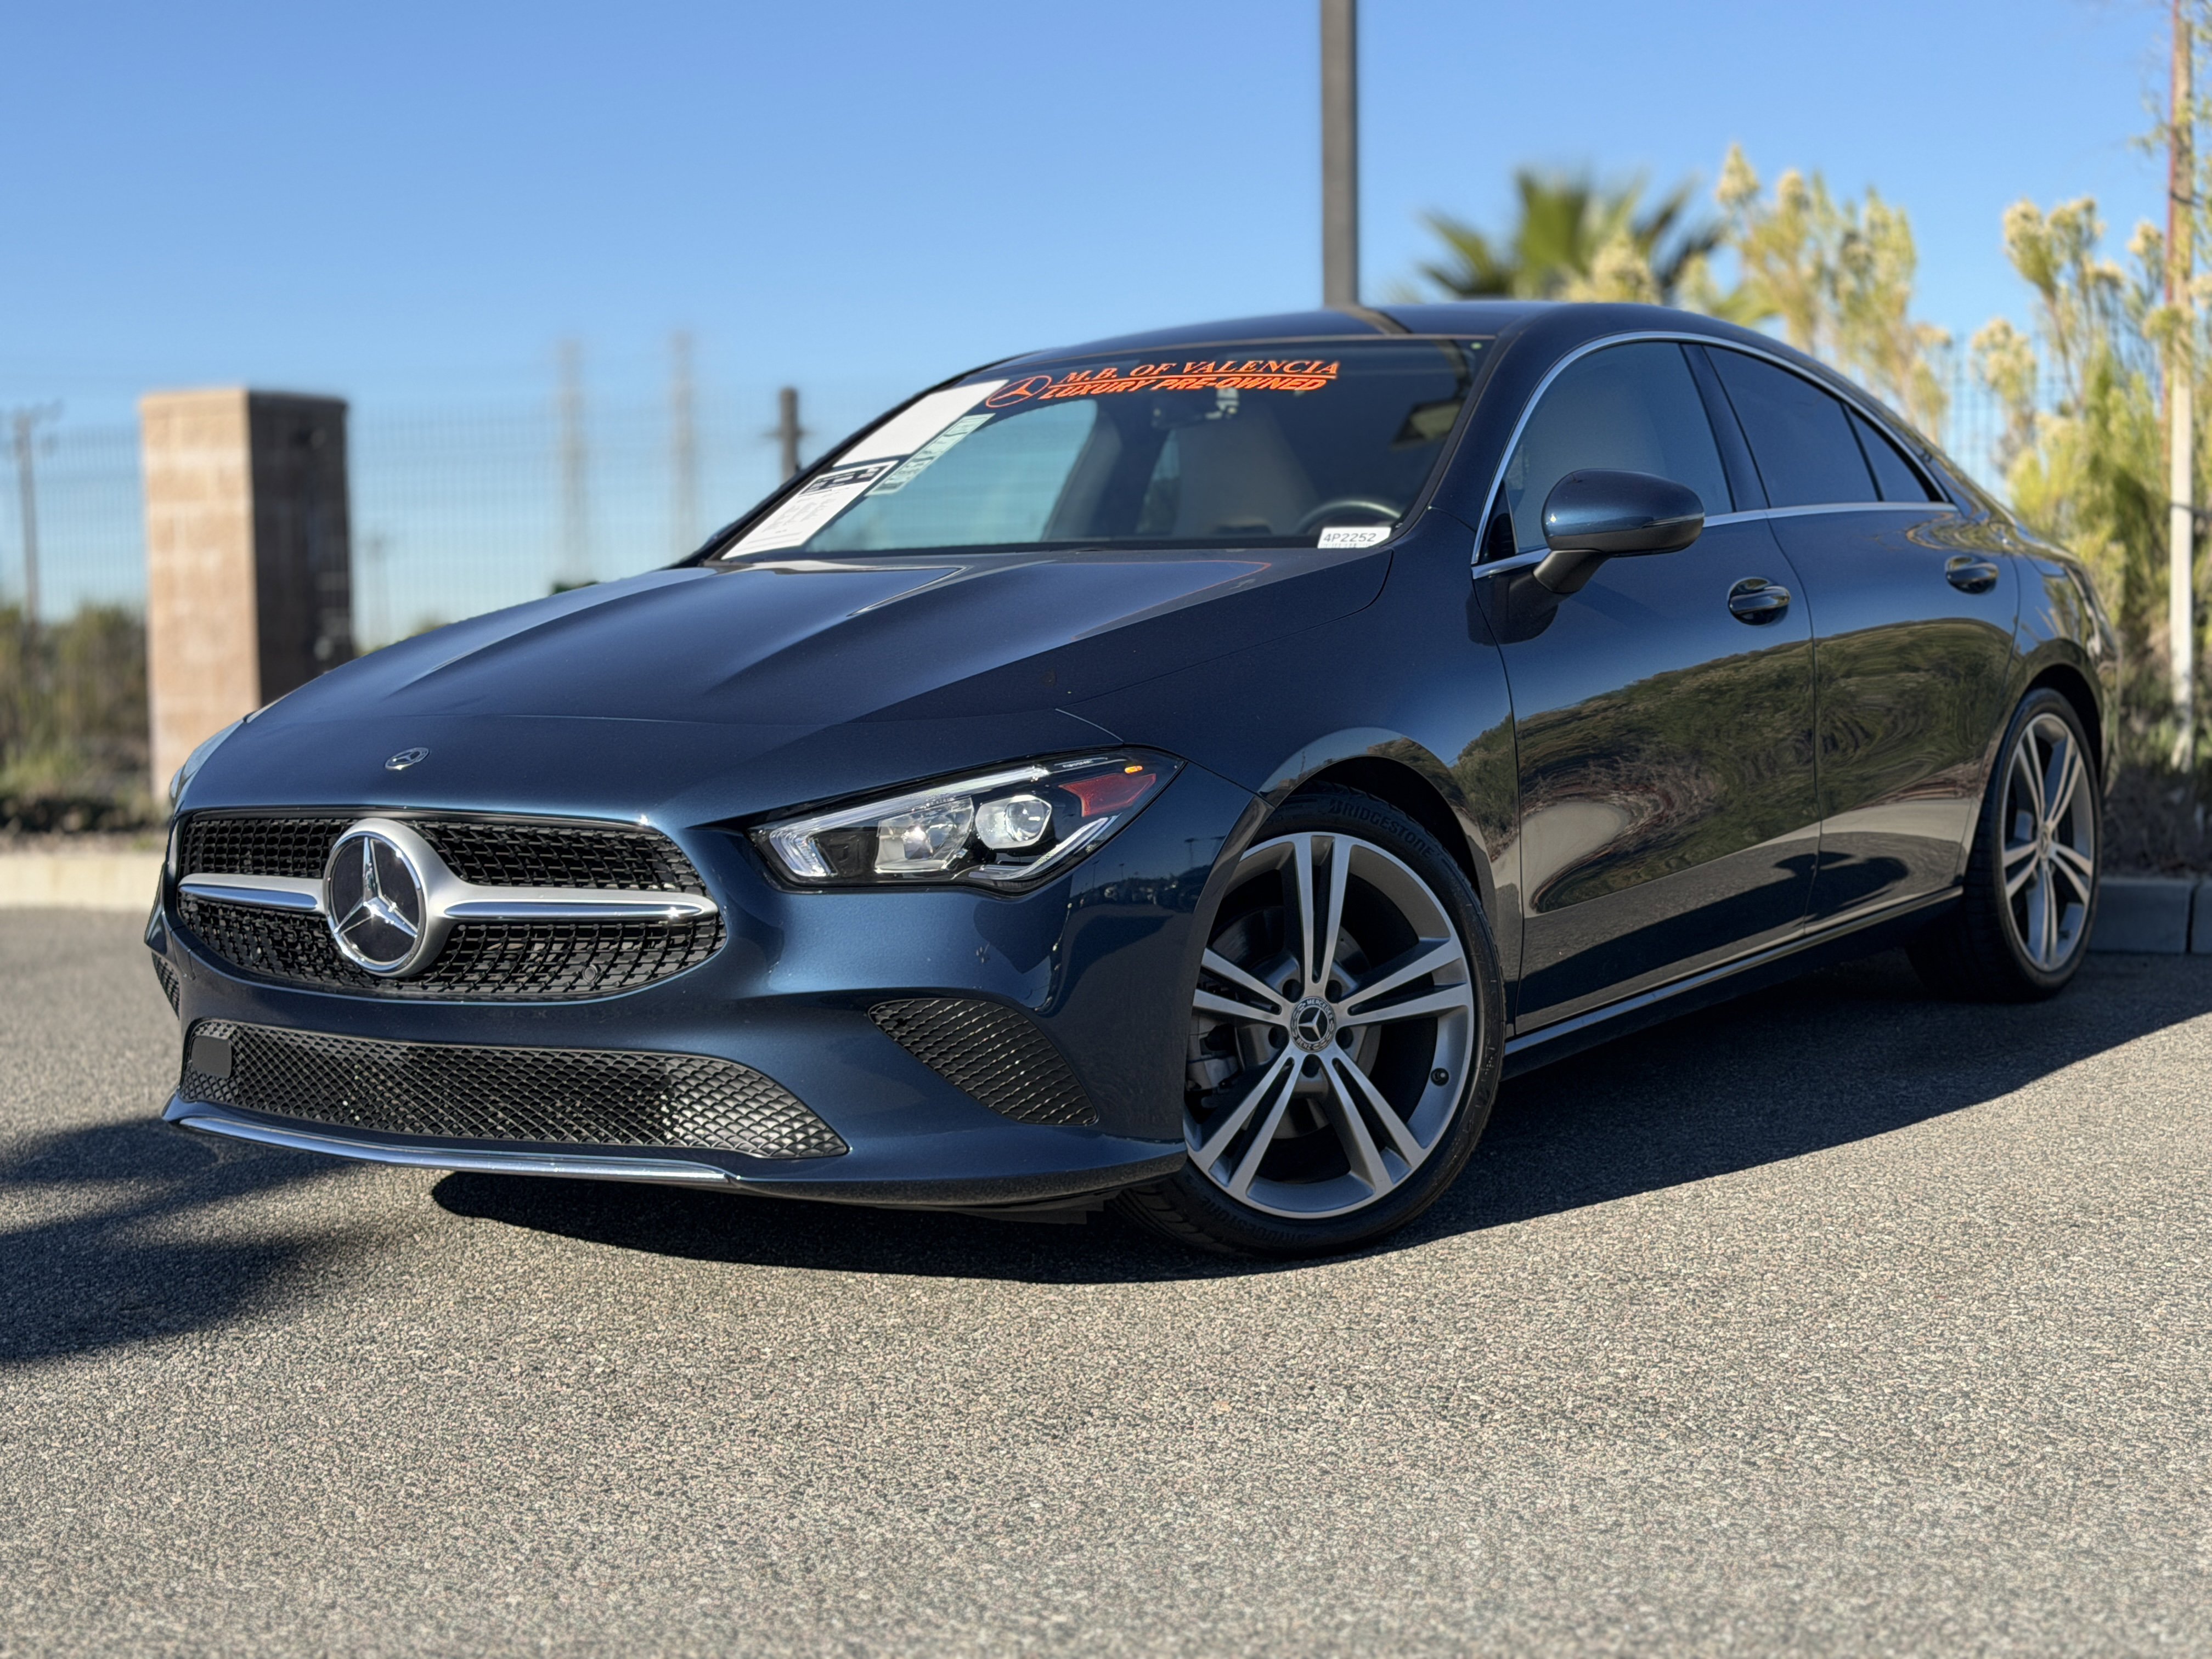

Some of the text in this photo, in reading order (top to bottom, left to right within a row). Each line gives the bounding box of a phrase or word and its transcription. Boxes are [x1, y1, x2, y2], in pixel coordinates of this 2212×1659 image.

[1057, 360, 1340, 383] M.B. OF VALENCIA
[1038, 377, 1327, 399] LUXURY PRE-OWNED
[1323, 533, 1376, 542] 4P2252
[1328, 798, 1435, 857] BRIDGESTONE
[1296, 1037, 1312, 1050] BENZ
